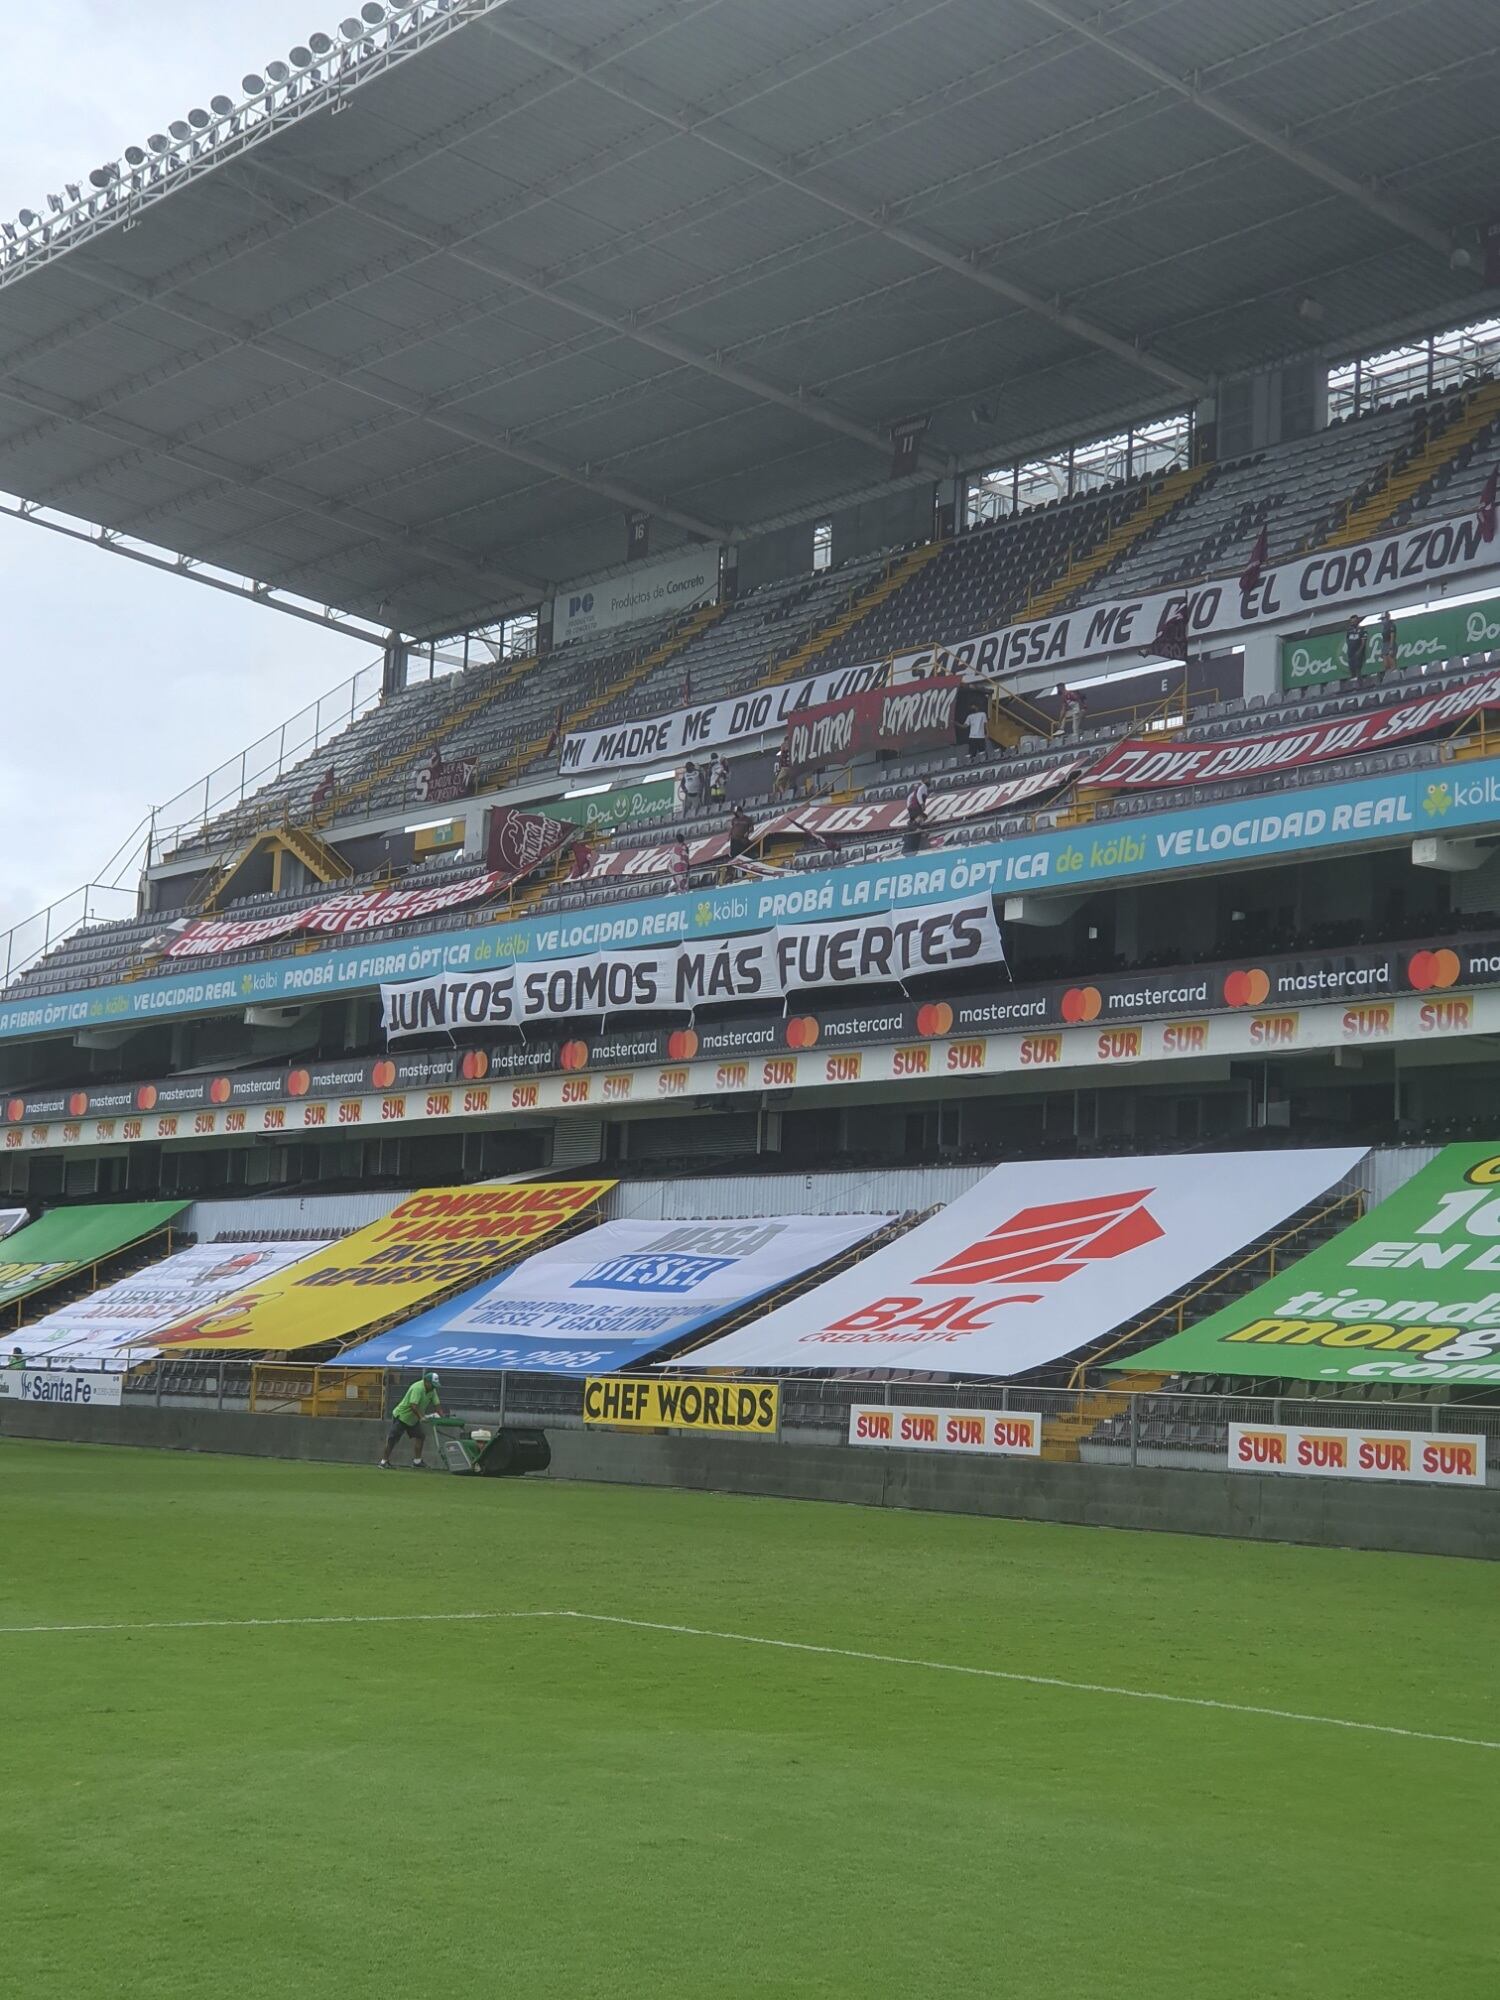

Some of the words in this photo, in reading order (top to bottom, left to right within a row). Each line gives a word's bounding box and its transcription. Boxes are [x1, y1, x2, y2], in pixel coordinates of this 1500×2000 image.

[611, 592, 651, 611] Productos
[653, 585, 664, 598] de
[666, 575, 705, 594] Concreto
[562, 738, 586, 767] MI
[592, 721, 675, 763] MADRE
[682, 705, 717, 746] ME
[728, 693, 774, 736] DIO
[777, 680, 816, 722] LA
[911, 619, 1071, 680] SAPRISSA
[1084, 603, 1143, 649] ME
[1240, 573, 1280, 620] EL
[1299, 519, 1482, 601] CORAZÓN
[1291, 648, 1337, 678] Dos
[1365, 632, 1447, 664] Pnos
[790, 707, 856, 765] CULTURA
[1134, 749, 1213, 785] OYE
[1205, 739, 1299, 778] COMO
[586, 803, 613, 824] Dos
[629, 792, 679, 817] Pinos
[789, 803, 892, 834] LOS
[10, 1009, 44, 1028] FIBRA
[45, 1002, 89, 1024] ÖPTICA
[134, 987, 204, 1011] VELOCIDAD
[206, 980, 238, 1001] REAL
[254, 970, 278, 990] kölbi
[283, 959, 334, 990] PROBÁ
[338, 963, 358, 985] LA
[359, 955, 406, 983] FIBRA
[408, 943, 471, 973] ÖPTICA
[476, 939, 491, 962] de
[497, 933, 530, 959] kölbi
[536, 918, 638, 952] VELOCIDAD
[642, 910, 689, 934] REAL
[713, 898, 748, 922] kölbi
[758, 880, 834, 919] PROBÁ
[841, 879, 874, 906] LA
[874, 868, 946, 903] FIBRA
[950, 852, 1050, 889] ÖPTICA
[1056, 845, 1083, 874] de
[1090, 834, 1147, 868] kölbi
[1156, 808, 1327, 859] VELOCIDAD
[1331, 795, 1413, 832] REAL
[169, 936, 230, 956] COMO
[307, 912, 348, 931] TU
[343, 880, 494, 932] EXISTENCIA
[389, 977, 515, 1032] JUNTOS
[524, 962, 659, 1015] SOMOS
[675, 941, 763, 1004] MÁS
[776, 906, 988, 991] FUERTES
[26, 1100, 65, 1114] mastercard
[89, 1092, 132, 1108] mastercard
[159, 1086, 204, 1101] mastercard
[233, 1080, 281, 1094] mastercard
[312, 1070, 364, 1087] mastercard
[398, 1059, 454, 1079] mastercard
[492, 1049, 551, 1070] mastercard
[592, 1039, 657, 1060] mastercard
[703, 1027, 774, 1048] mastercard
[824, 1013, 903, 1037] mastercard
[959, 998, 1046, 1023] mastercard
[1108, 983, 1207, 1010] mastercard
[1278, 963, 1390, 992] mastercard
[6, 1130, 22, 1147] SUR
[63, 1125, 80, 1142] SUR
[96, 1122, 114, 1140] SUR
[123, 1120, 142, 1139] SUR
[158, 1116, 177, 1136] SUR
[195, 1114, 214, 1133] SUR
[225, 1112, 245, 1131] SUR
[264, 1109, 284, 1128] SUR
[304, 1106, 325, 1124] SUR
[338, 1104, 360, 1122] SUR
[382, 1100, 403, 1119] SUR
[427, 1095, 449, 1115] SUR
[464, 1091, 488, 1112] SUR
[512, 1087, 537, 1108] SUR
[562, 1082, 588, 1103] SUR
[603, 1076, 630, 1099] SUR
[658, 1071, 686, 1094] SUR
[716, 1065, 746, 1089] SUR
[763, 1061, 794, 1085] SUR
[826, 1056, 857, 1081] SUR
[893, 1049, 928, 1074] SUR
[947, 1044, 984, 1070] SUR
[1020, 1039, 1057, 1065] SUR
[1097, 1032, 1138, 1060] SUR
[1163, 1024, 1205, 1053] SUR
[1250, 1016, 1295, 1046] SUR
[1342, 1007, 1390, 1038] SUR
[1419, 1002, 1470, 1033] SUR
[390, 1185, 604, 1219] CONFIANZA
[371, 1220, 405, 1242] Y
[402, 1212, 566, 1242] AHORRO
[632, 1223, 789, 1257] MEGA
[359, 1243, 414, 1265] EN
[410, 1238, 520, 1265] CADA
[1346, 1241, 1474, 1269] EN
[292, 1261, 484, 1287] REPUESTO
[580, 1256, 726, 1286] DIESEL
[467, 1311, 545, 1327] DIESEL
[540, 1313, 562, 1328] Y
[557, 1315, 671, 1332] GASOLINA
[472, 1299, 590, 1318] LABORATORIO
[589, 1304, 620, 1317] DE
[820, 1294, 1046, 1331] BAC
[798, 1331, 973, 1343] CREDOMATIC
[32, 1375, 73, 1402] Santa
[74, 1377, 92, 1403] Fe
[585, 1382, 650, 1421] CHEF
[657, 1384, 774, 1428] WORLDS
[856, 1416, 891, 1440] SUR
[900, 1418, 936, 1442] SUR
[946, 1420, 983, 1446] SUR
[994, 1423, 1033, 1448] SUR
[1238, 1436, 1285, 1465] SUR
[1297, 1440, 1347, 1468] SUR
[1358, 1443, 1410, 1471] SUR
[1422, 1446, 1476, 1476] SUR
